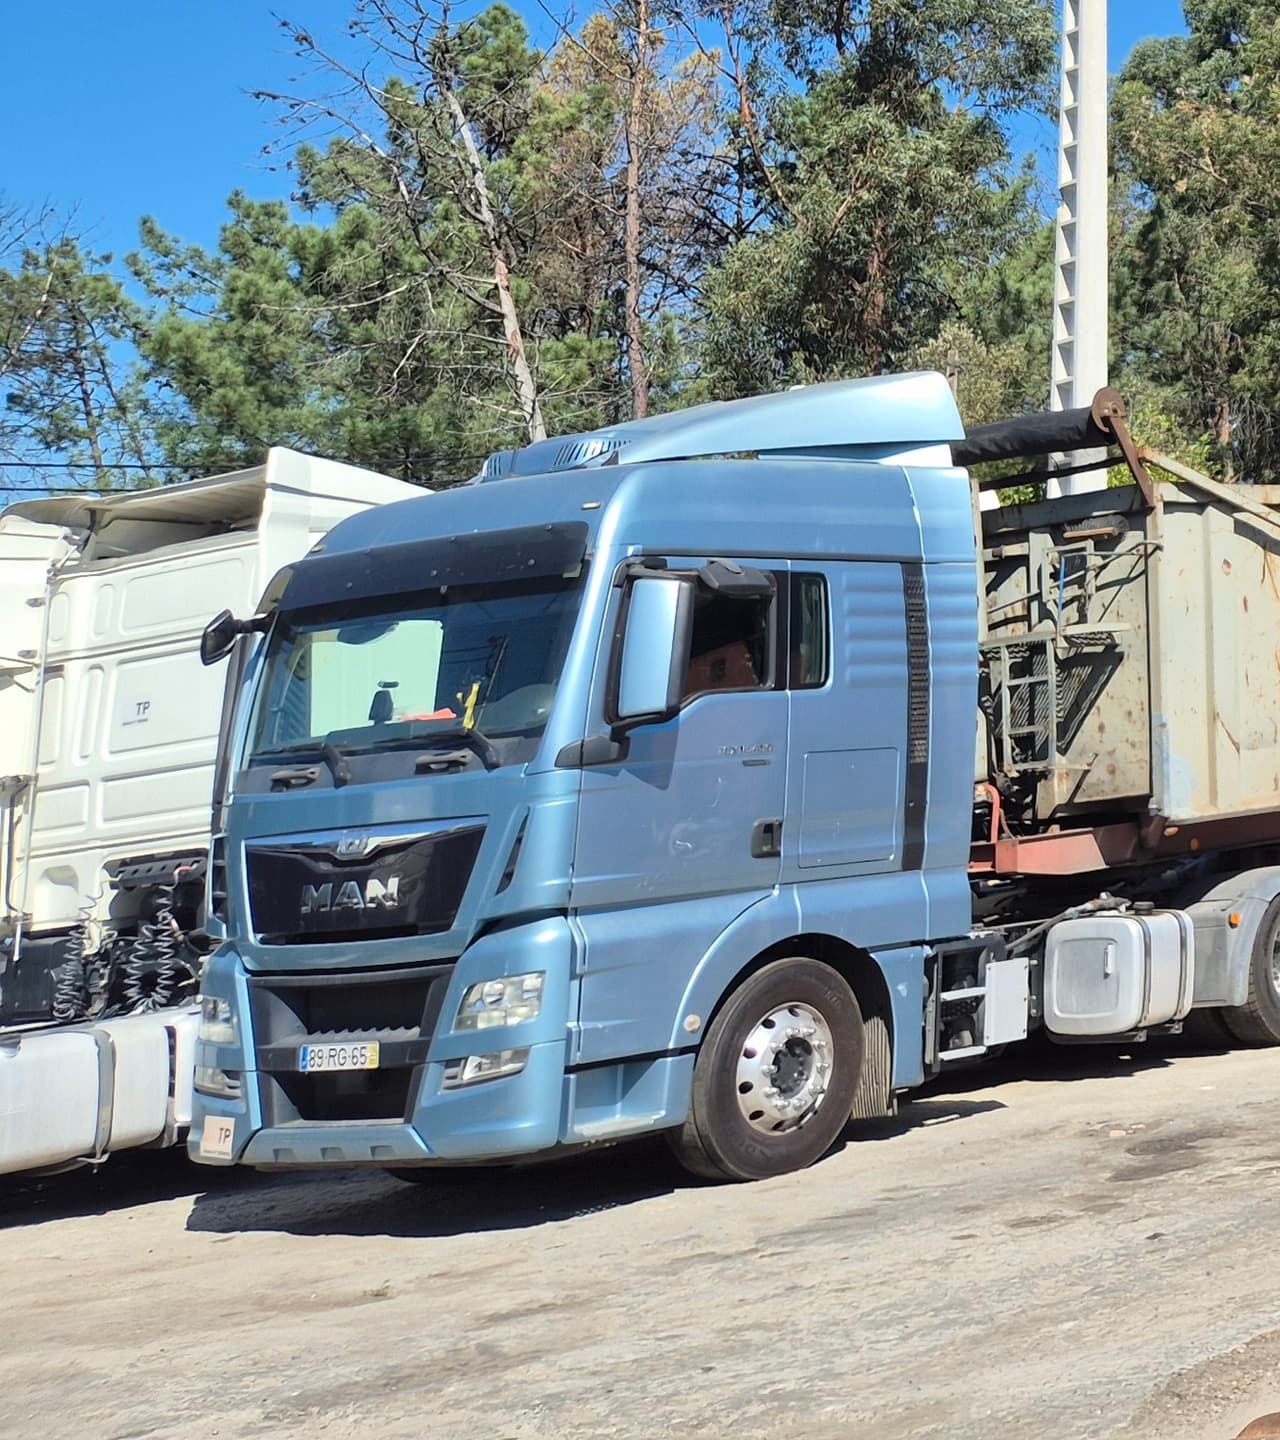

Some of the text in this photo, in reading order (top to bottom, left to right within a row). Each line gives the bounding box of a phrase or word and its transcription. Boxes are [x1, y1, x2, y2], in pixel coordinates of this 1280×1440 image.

[136, 701, 150, 715] TP
[301, 877, 400, 913] MAN
[218, 1127, 231, 1144] TP
